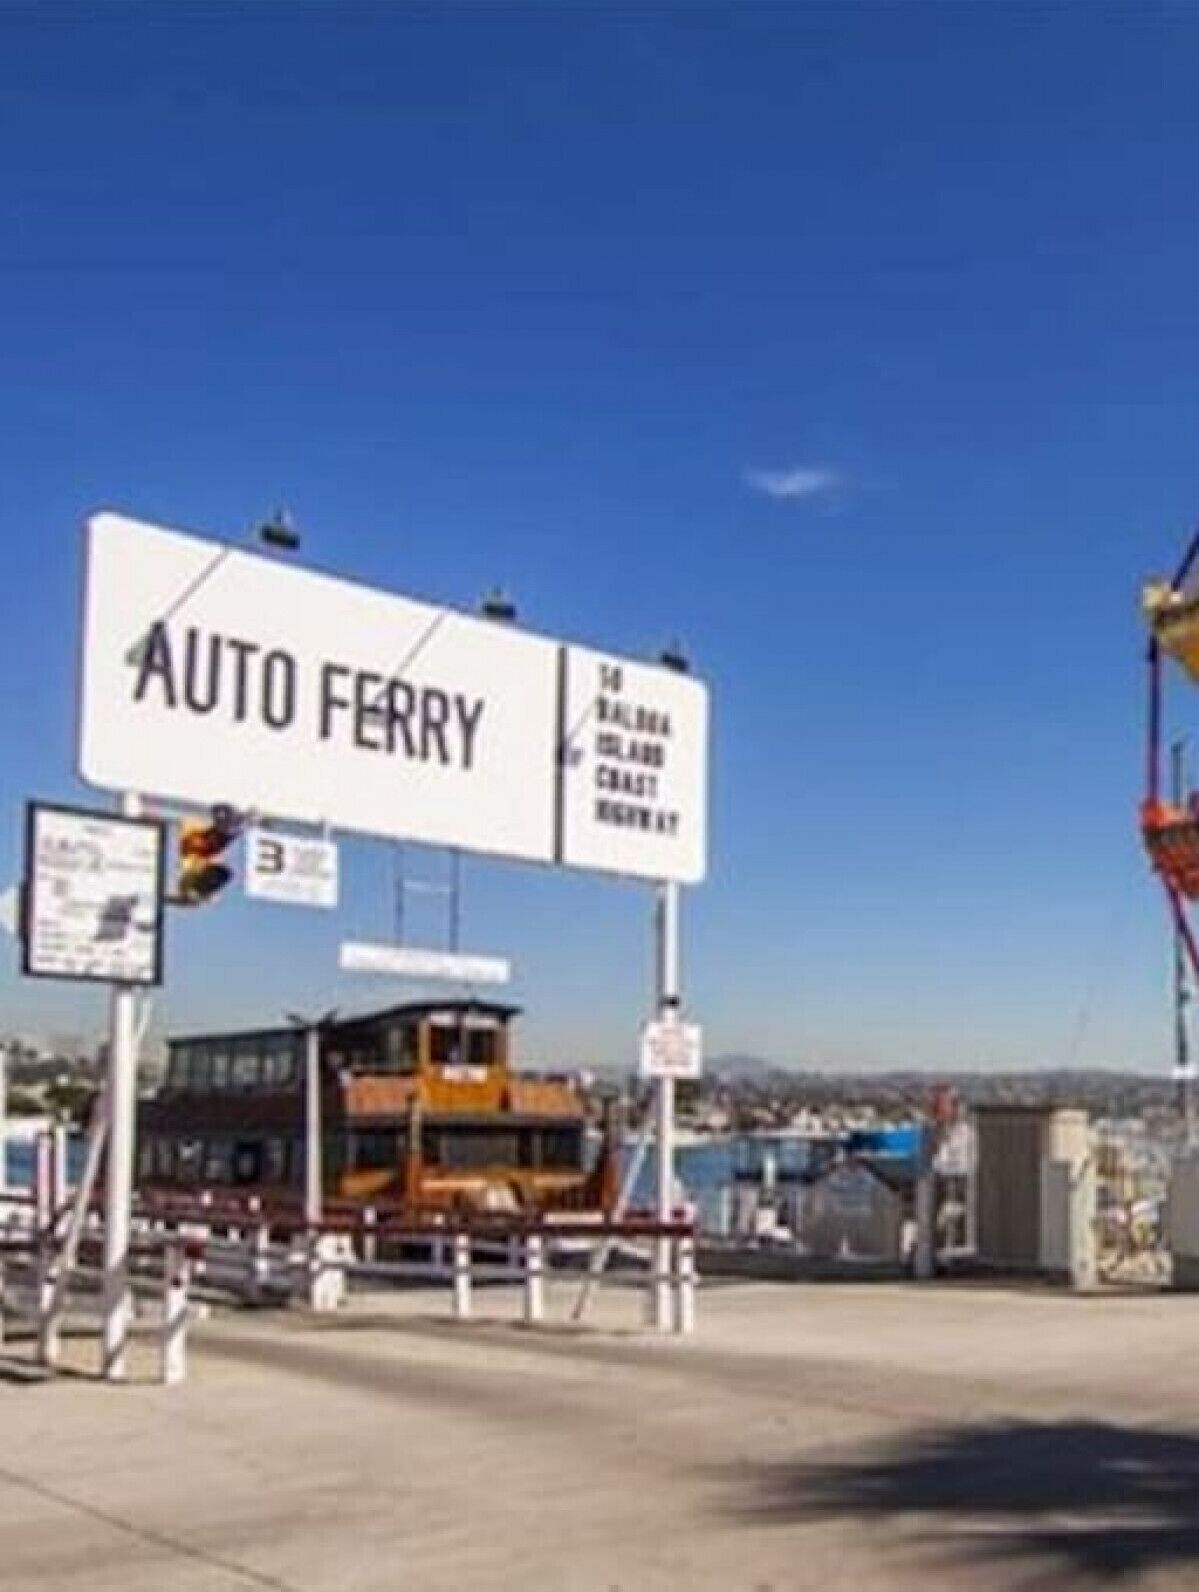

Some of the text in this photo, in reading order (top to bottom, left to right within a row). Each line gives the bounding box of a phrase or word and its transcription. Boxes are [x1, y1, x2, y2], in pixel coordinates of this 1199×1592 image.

[134, 620, 485, 771] AUTO FERRY
[597, 732, 664, 769] ISLAND
[597, 763, 658, 799] COAST
[597, 799, 679, 838] HIGHWAY
[256, 839, 285, 875] 3
